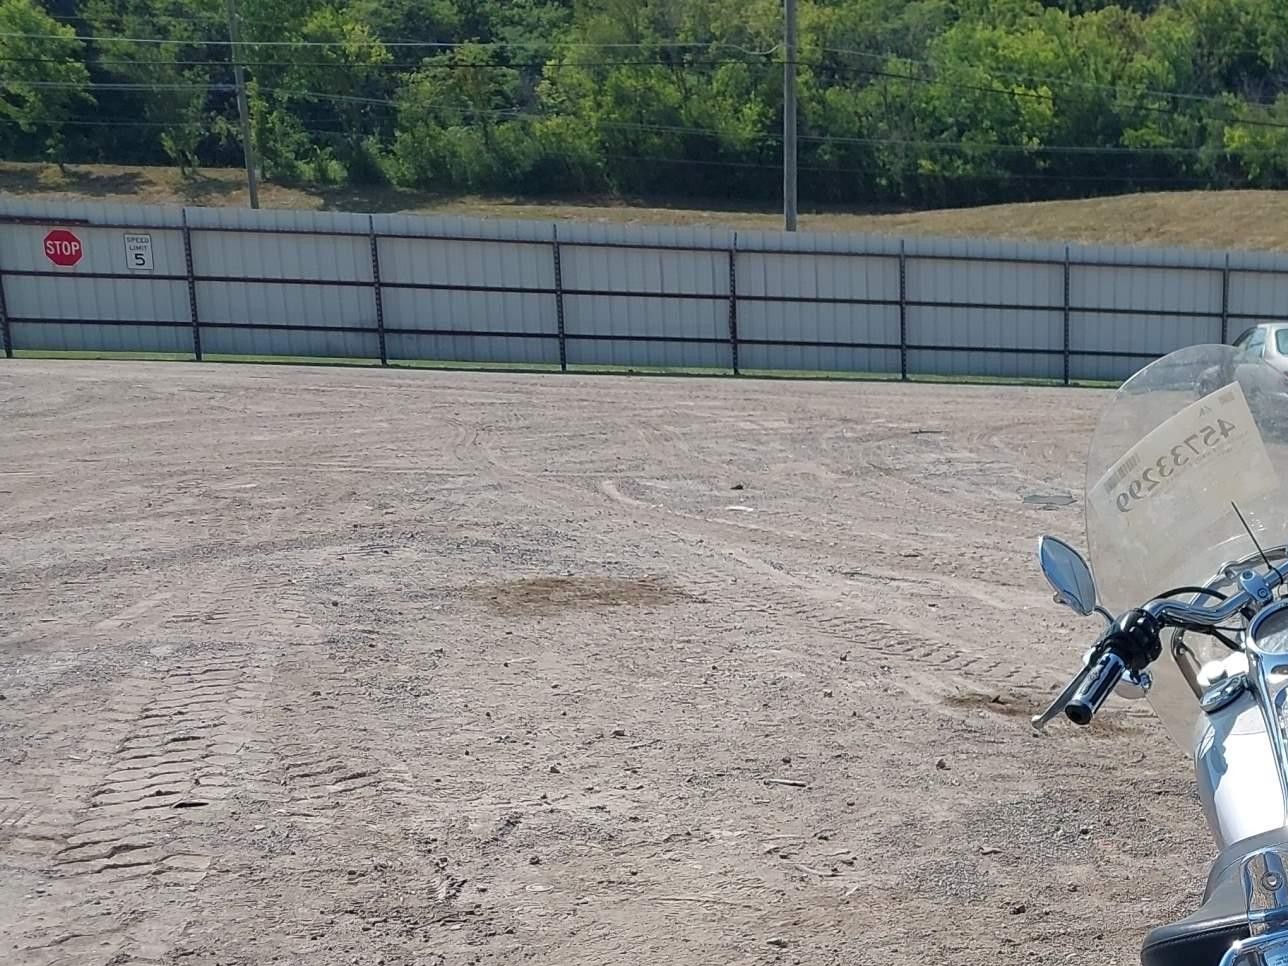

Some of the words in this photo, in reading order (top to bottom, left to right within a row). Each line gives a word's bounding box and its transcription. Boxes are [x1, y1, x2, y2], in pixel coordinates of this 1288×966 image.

[126, 236, 150, 244] SPEED
[46, 240, 80, 256] STOP
[134, 253, 146, 266] 5
